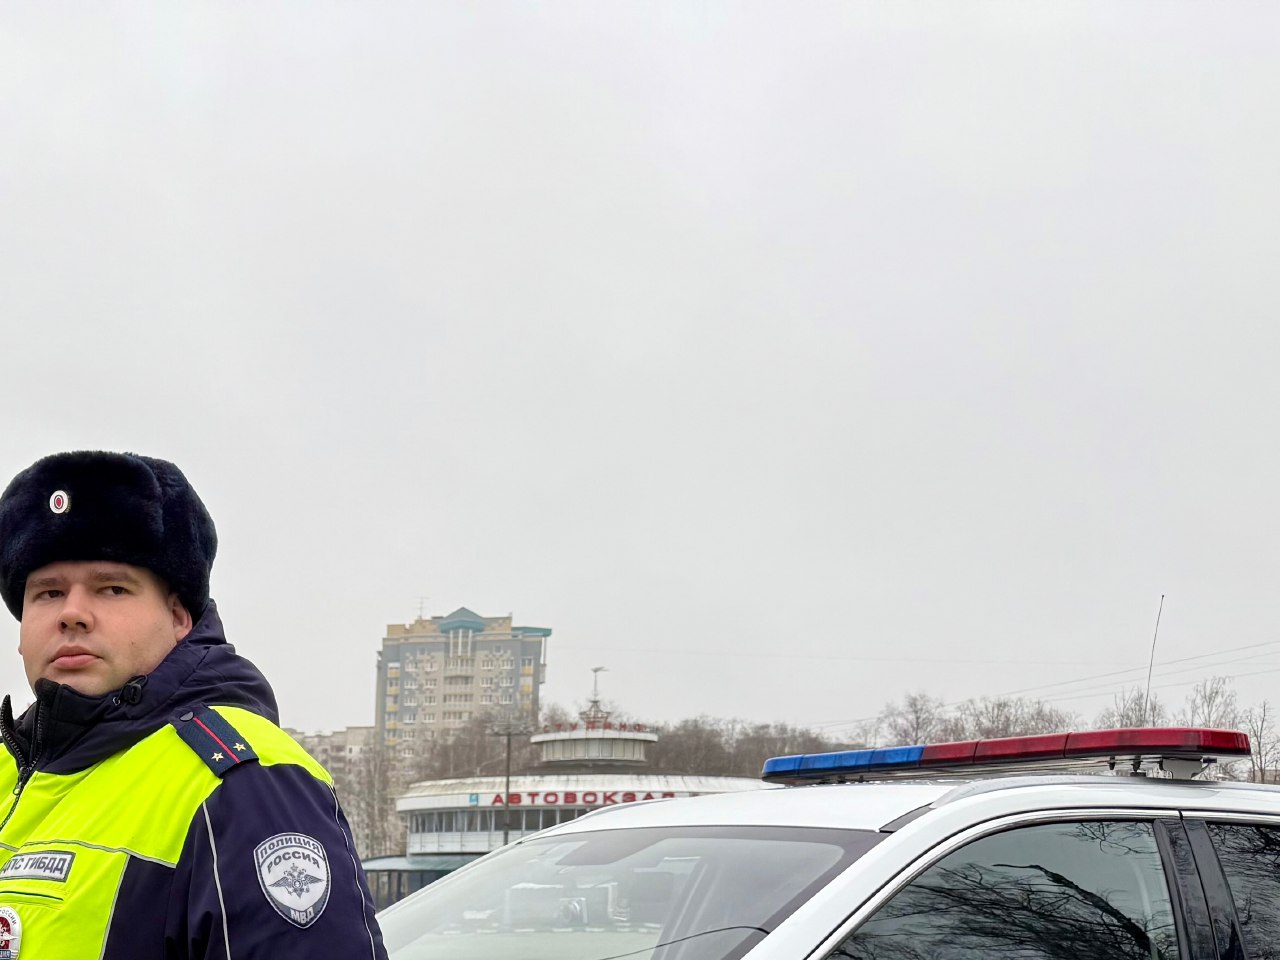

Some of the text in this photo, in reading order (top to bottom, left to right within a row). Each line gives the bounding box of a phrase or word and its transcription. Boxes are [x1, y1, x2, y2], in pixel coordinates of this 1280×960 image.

[260, 837, 321, 859] ПОЛИЦИЯ
[23, 856, 67, 875] ГИБДД
[267, 851, 320, 874] РОССИЯ
[290, 907, 315, 924] МВД
